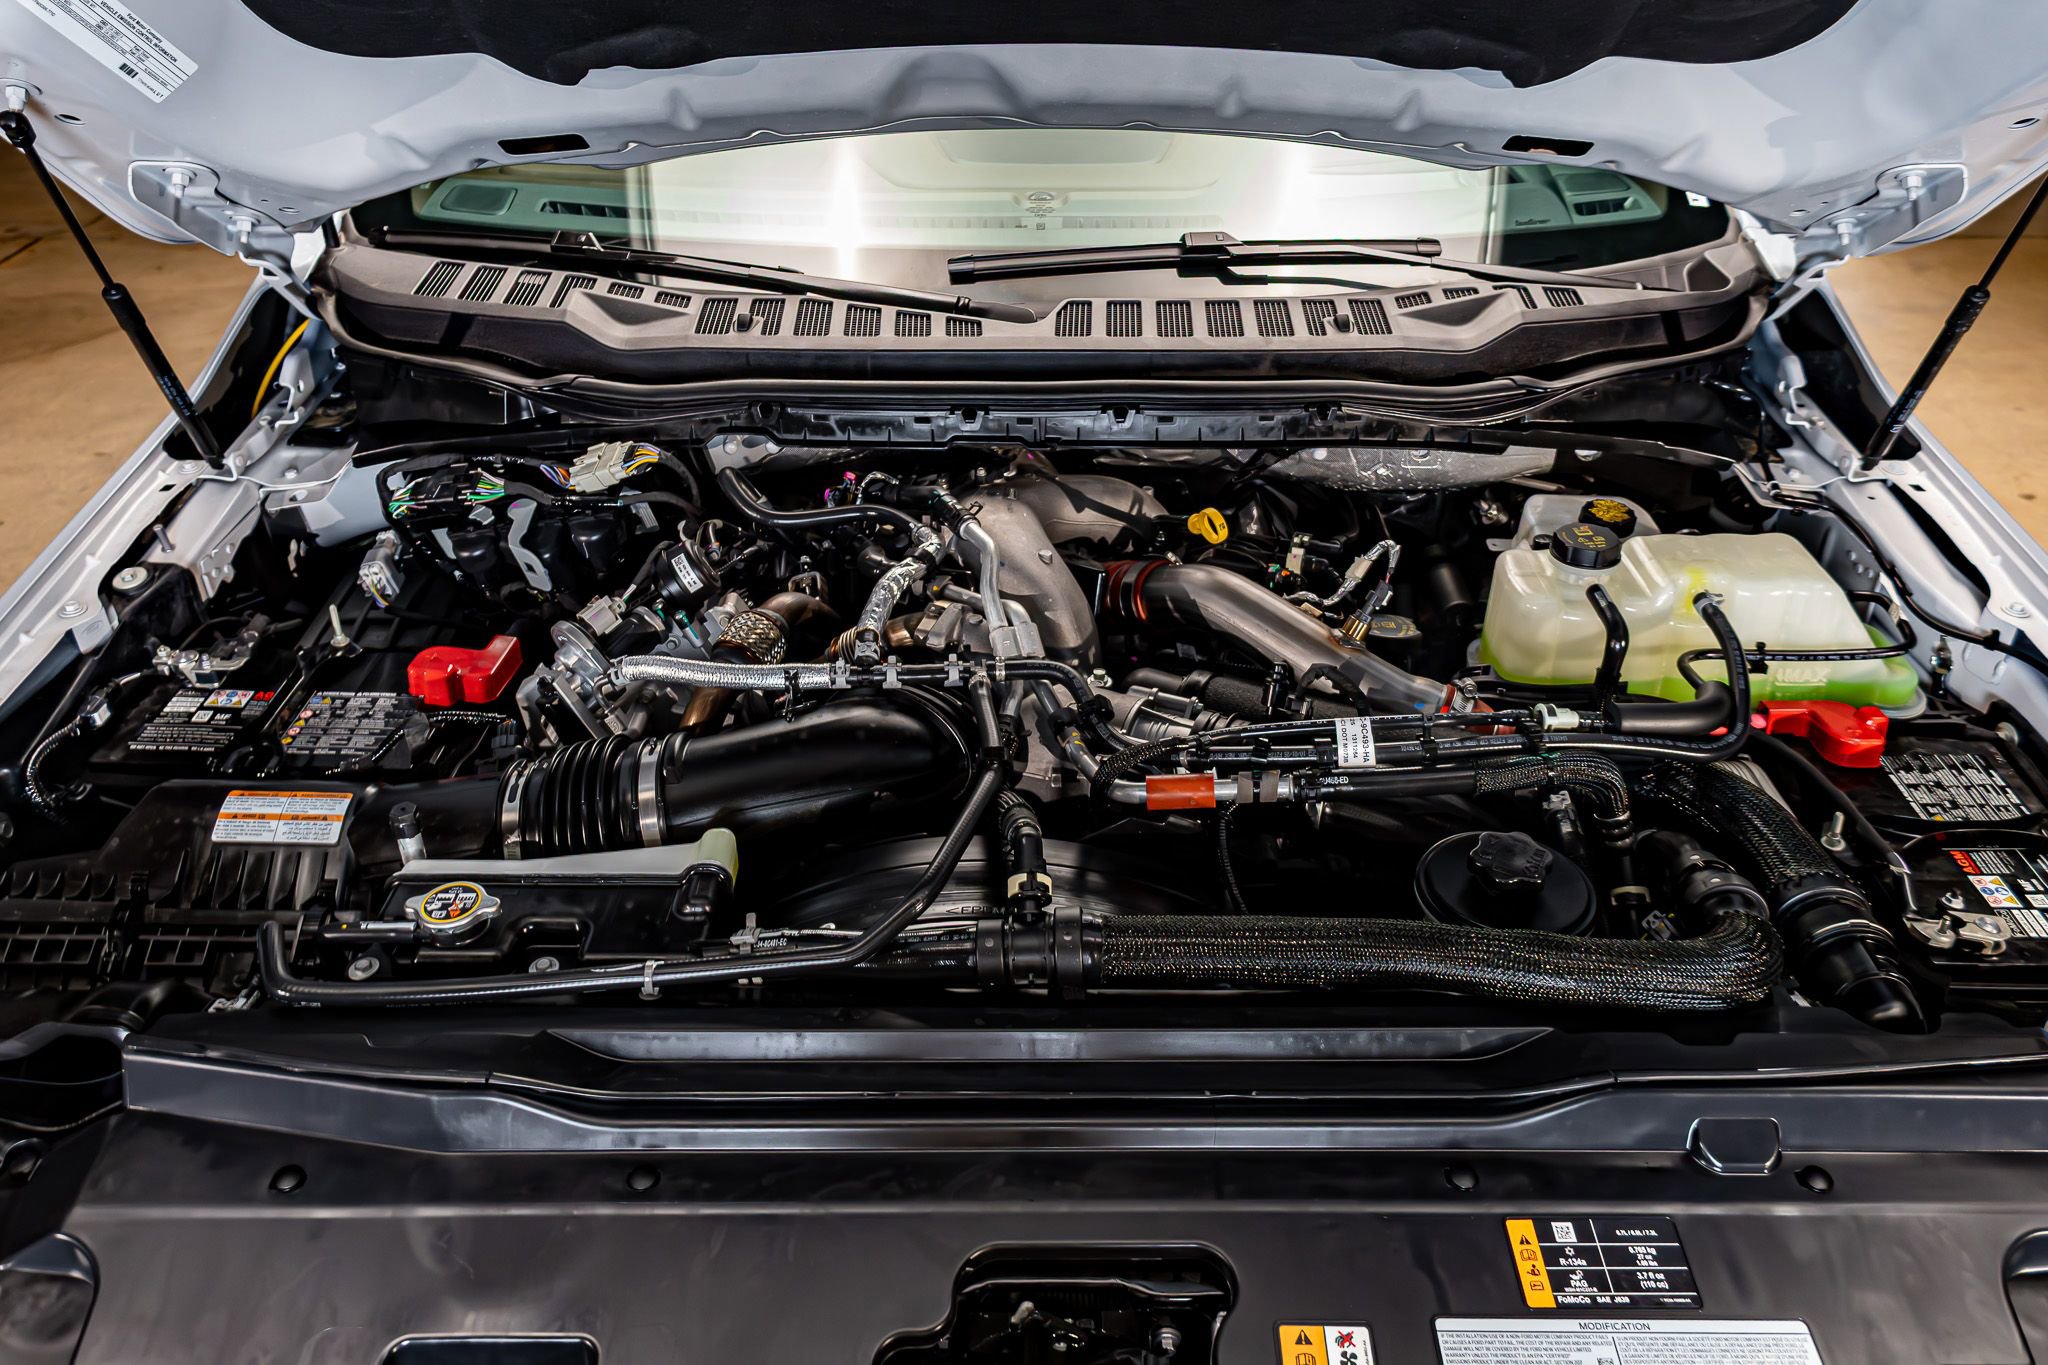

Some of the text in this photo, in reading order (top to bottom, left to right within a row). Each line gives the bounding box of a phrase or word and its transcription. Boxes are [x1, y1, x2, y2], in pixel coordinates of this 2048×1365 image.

[100, 0, 118, 16] VEHICLE
[117, 13, 136, 30] EMISSION
[135, 28, 154, 44] CONTROL
[153, 42, 178, 63] INFORMATION
[127, 13, 163, 43] Ford Motor Company
[253, 691, 275, 701] AG
[1949, 851, 1976, 874] AGM
[1648, 1247, 1656, 1255] kg
[1559, 1258, 1587, 1266] R-134a
[1640, 1281, 1669, 1289] (110 cc)
[1558, 1296, 1590, 1304] FoMoCo
[1596, 1296, 1612, 1304] SAE
[1578, 1321, 1651, 1332] MODIFICATION
